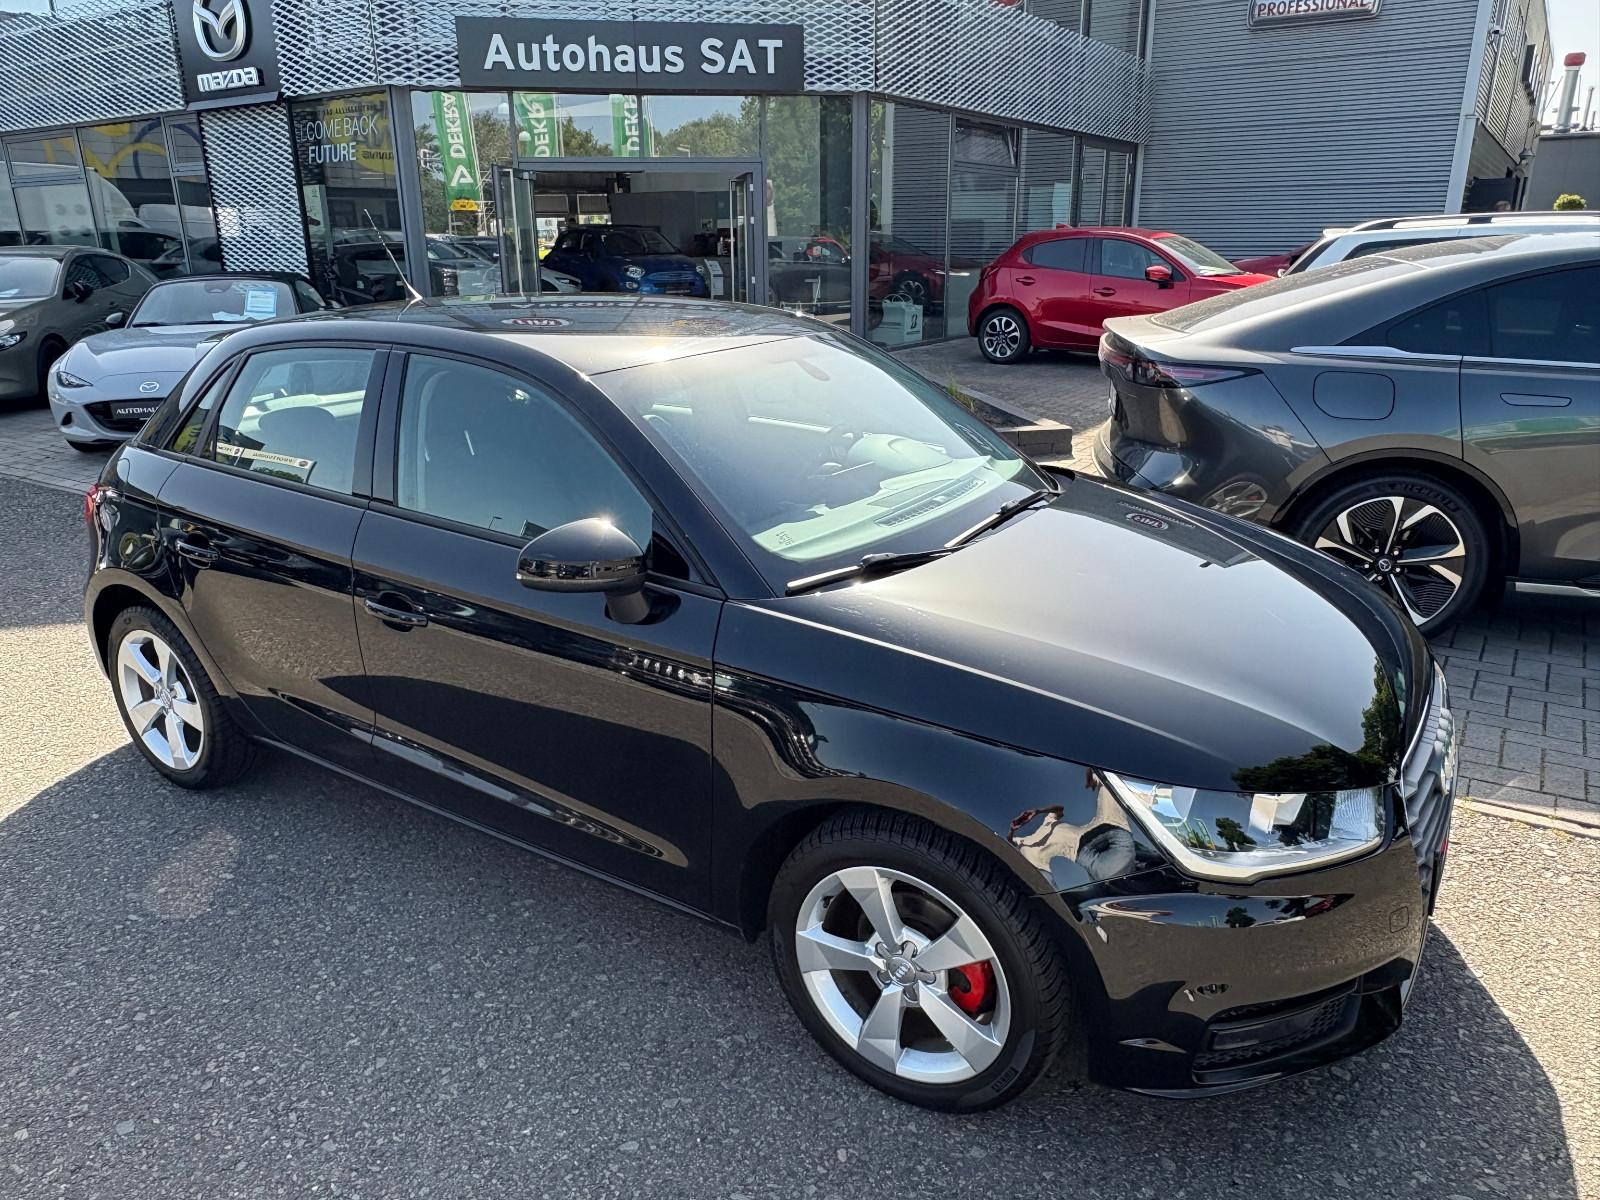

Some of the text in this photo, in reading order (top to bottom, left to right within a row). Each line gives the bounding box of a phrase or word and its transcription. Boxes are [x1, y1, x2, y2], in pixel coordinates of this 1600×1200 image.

[1256, 0, 1369, 16] PROFESSIONAL
[484, 33, 783, 74] Autohaus SAT
[344, 115, 378, 137] BACK
[308, 141, 357, 164] FUTURE
